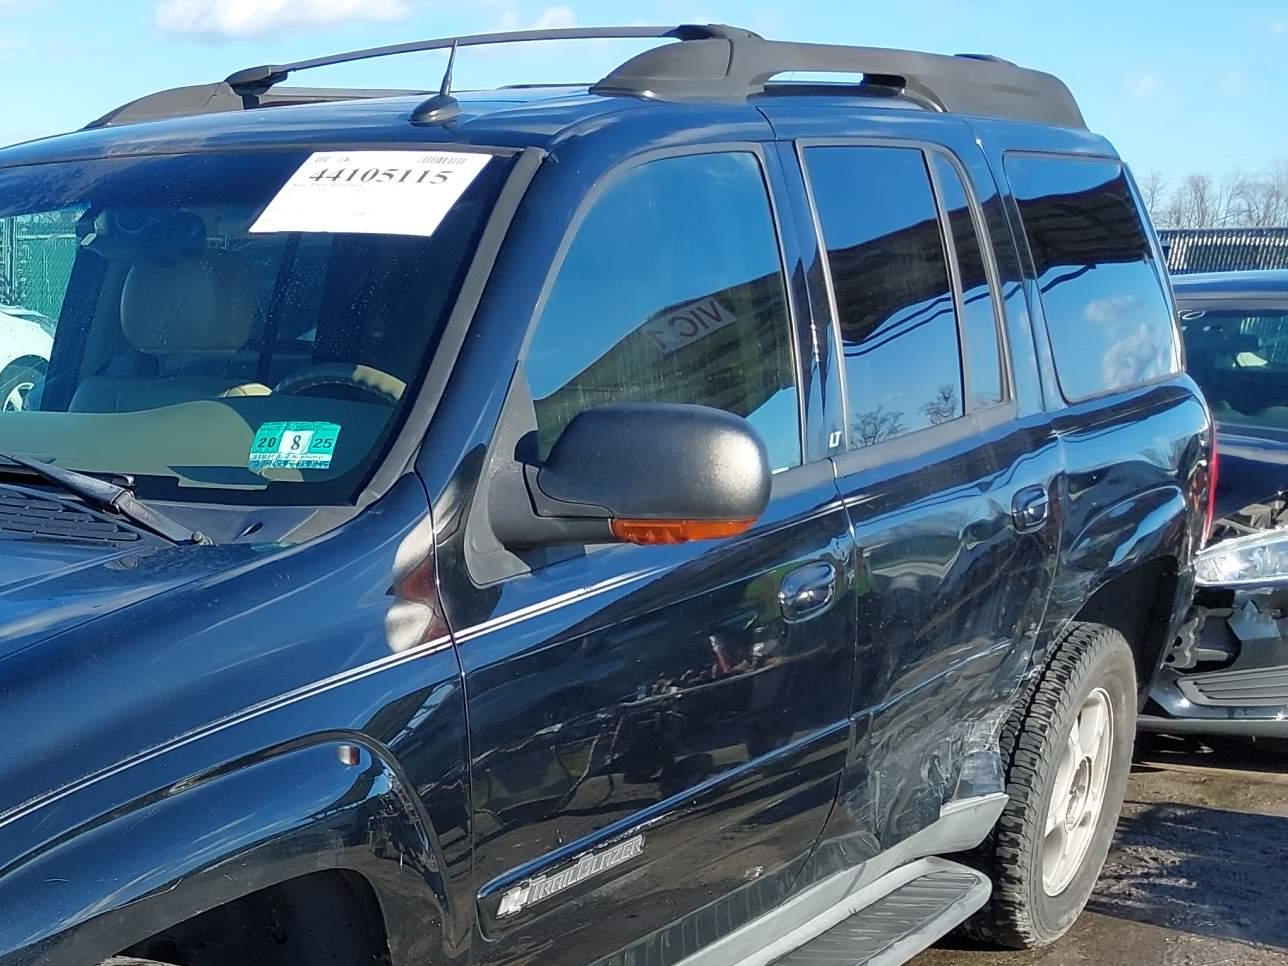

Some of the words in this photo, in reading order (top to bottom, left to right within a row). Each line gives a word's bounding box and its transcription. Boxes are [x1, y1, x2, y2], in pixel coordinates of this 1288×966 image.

[308, 166, 454, 185] 44105115
[257, 437, 277, 448] 20
[290, 434, 302, 451] 8
[312, 438, 332, 449] 25
[828, 430, 842, 449] LT
